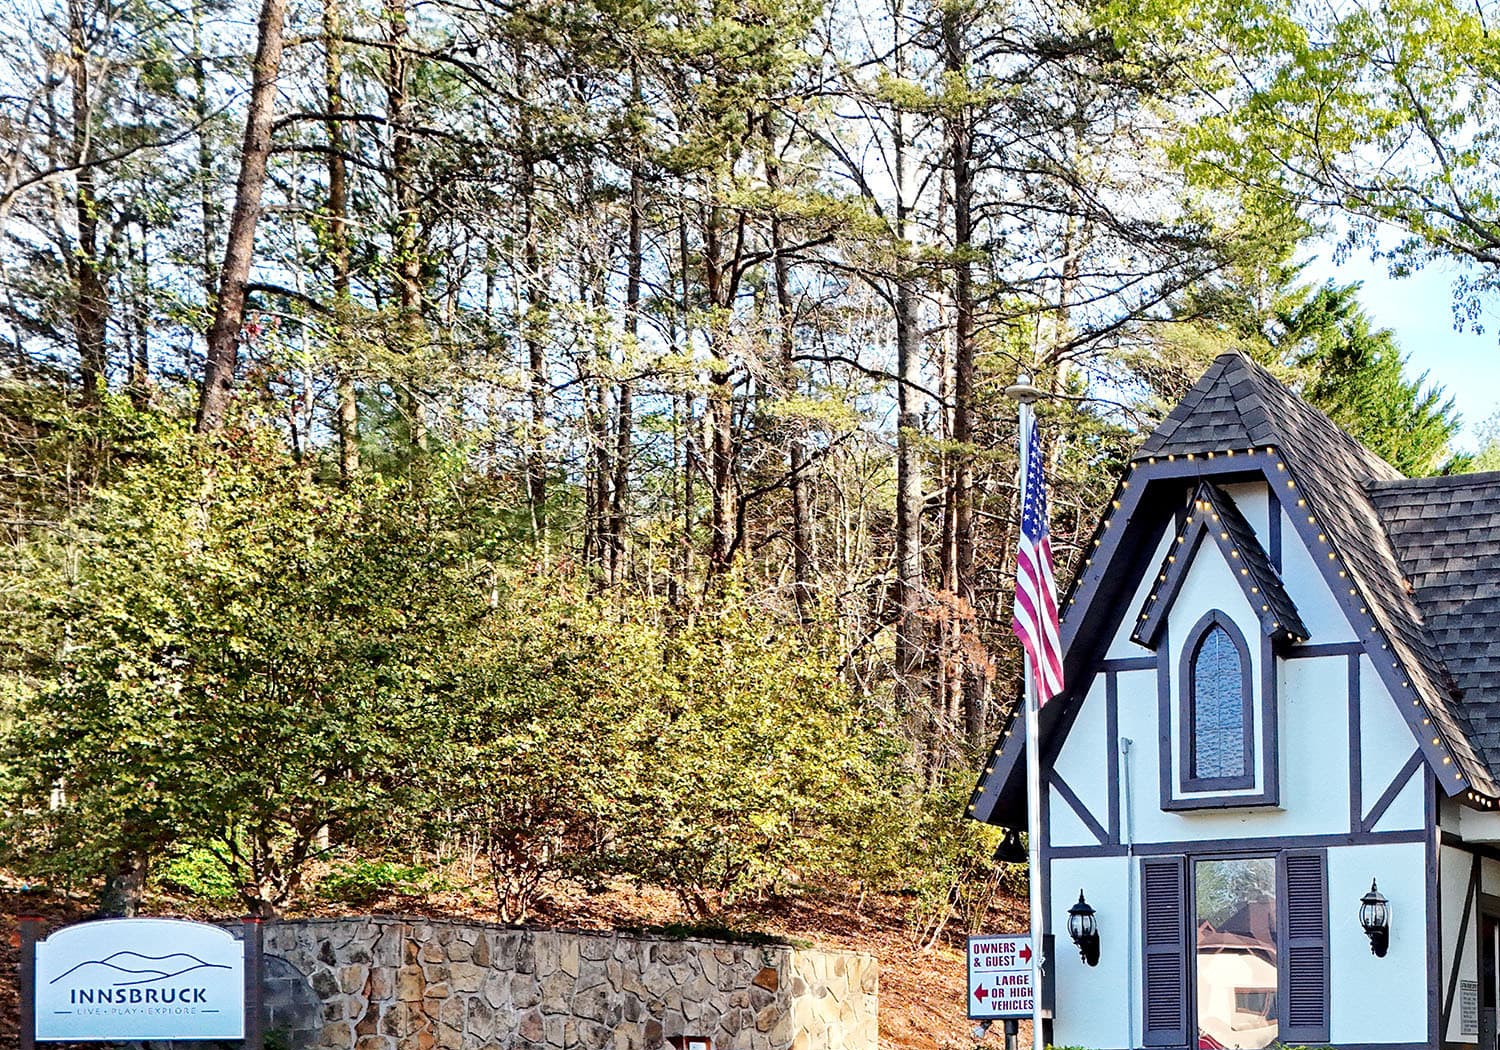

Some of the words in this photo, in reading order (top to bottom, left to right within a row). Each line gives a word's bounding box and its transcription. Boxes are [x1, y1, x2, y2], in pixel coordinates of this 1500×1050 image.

[973, 942, 1016, 954] OWNERS
[973, 957, 982, 967] &
[985, 955, 1016, 967] GUEST
[996, 975, 1029, 986] LARGE
[70, 988, 208, 1004] INNSBRUCK
[991, 988, 1005, 998] OR
[1010, 987, 1033, 998] HIGH
[77, 1007, 101, 1015] LIVE
[111, 1007, 137, 1015] PLAY
[148, 1006, 197, 1015] EXPLORE
[991, 1000, 1034, 1011] VEHICLES
